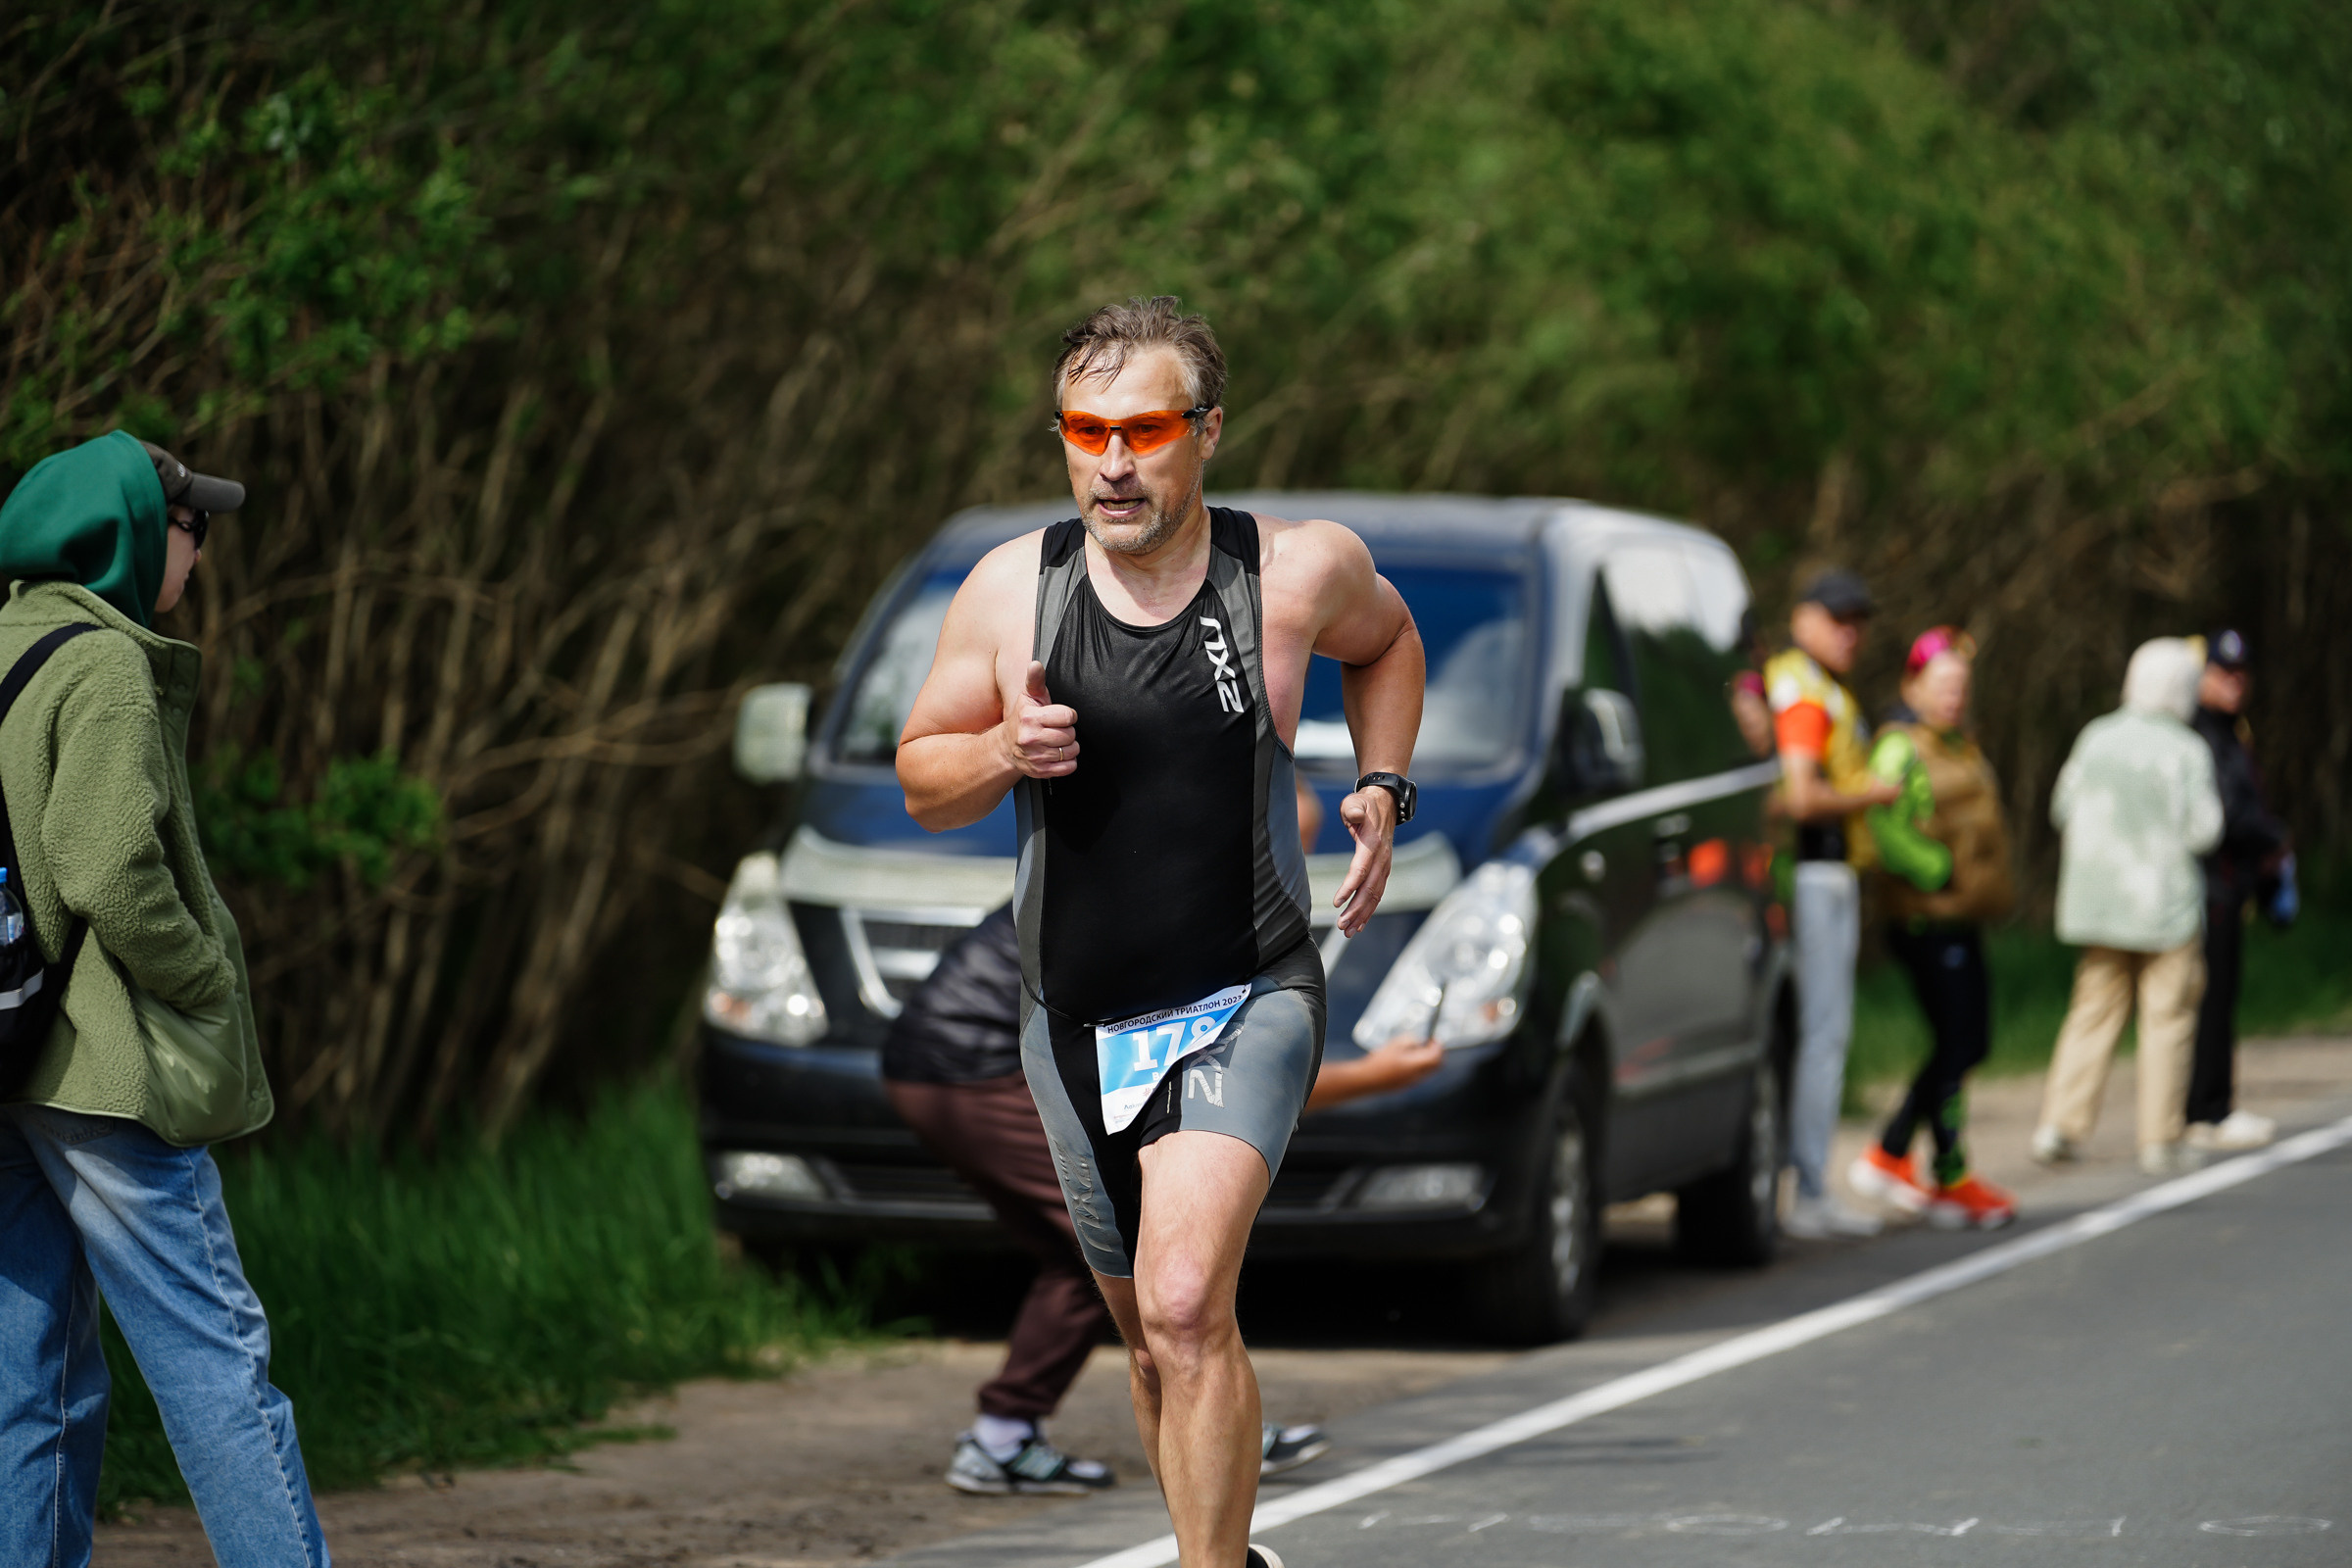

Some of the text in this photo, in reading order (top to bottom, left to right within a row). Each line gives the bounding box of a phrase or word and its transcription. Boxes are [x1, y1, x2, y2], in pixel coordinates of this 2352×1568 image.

[1200, 616, 1245, 713] 2XU
[1107, 995, 1242, 1033] НОВГОРОДСКИЙ ТРИАТЛОН 2023
